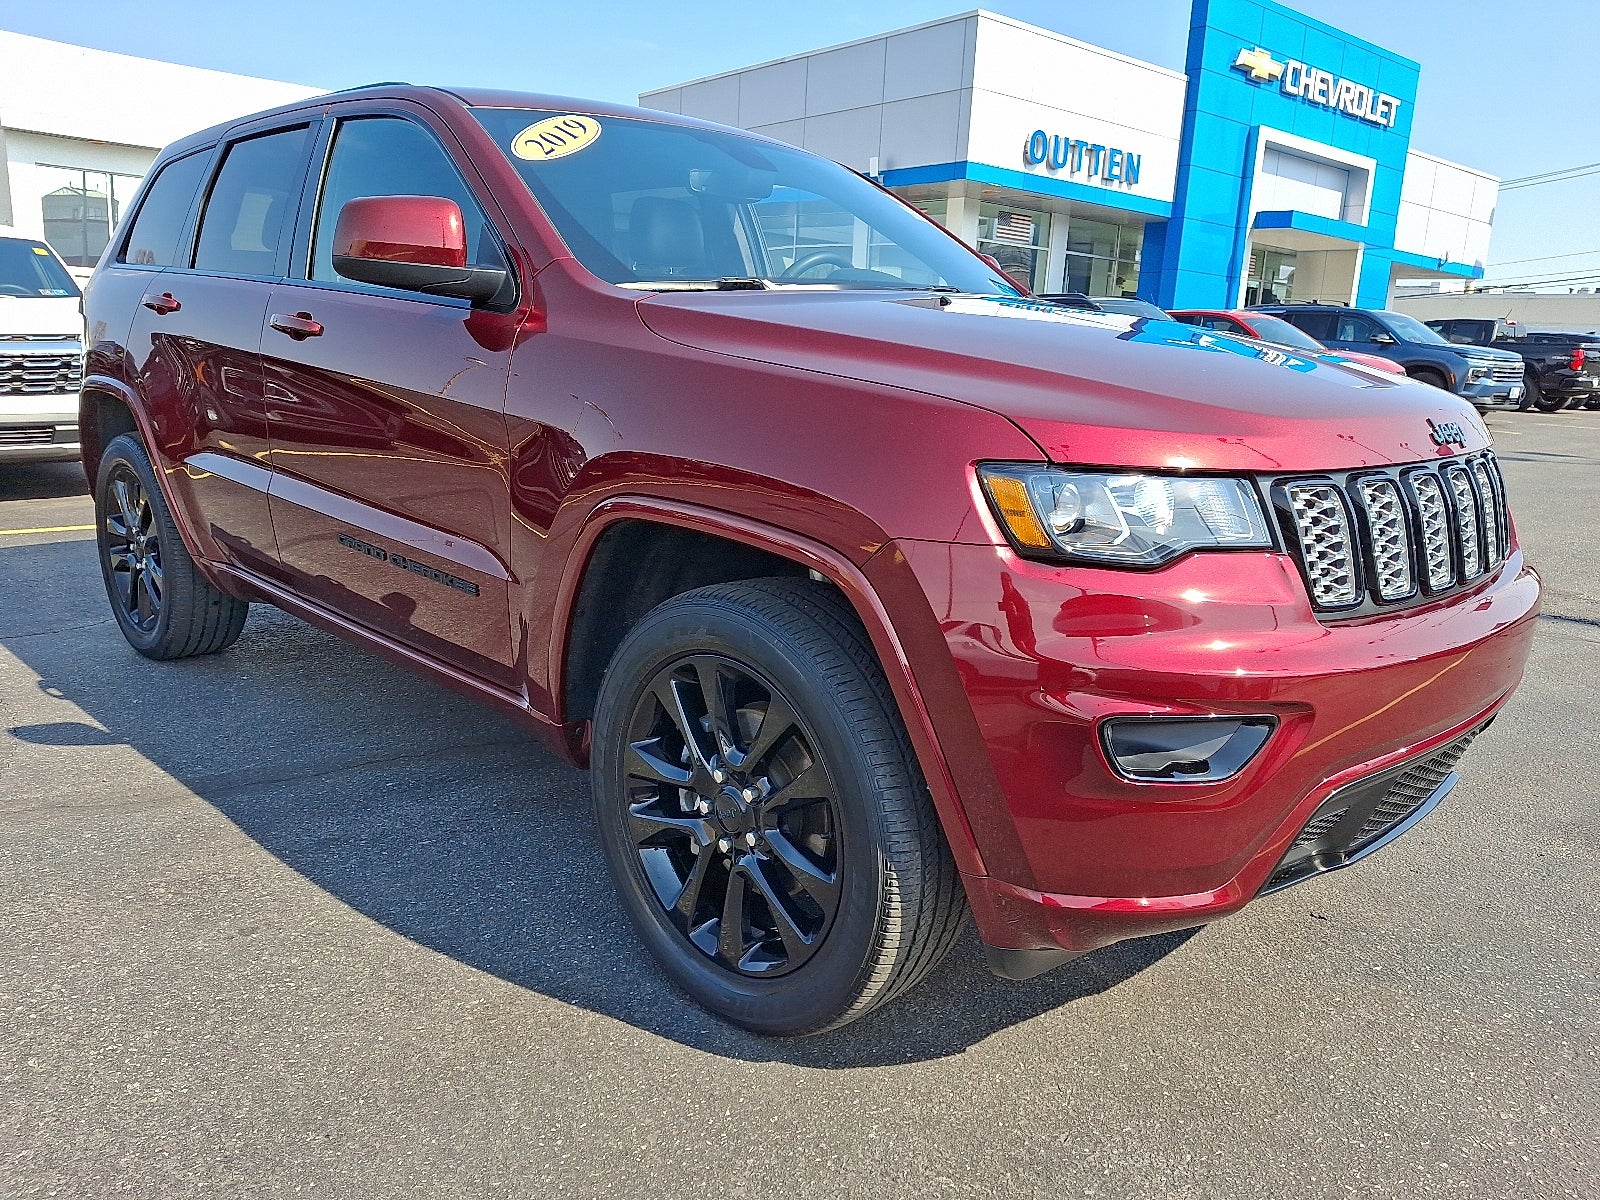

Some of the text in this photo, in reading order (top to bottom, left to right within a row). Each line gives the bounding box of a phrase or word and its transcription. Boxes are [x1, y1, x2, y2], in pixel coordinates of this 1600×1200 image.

[1284, 59, 1401, 128] CHEVROLET
[524, 119, 587, 155] 2019
[1027, 130, 1141, 185] OUTTEN
[1426, 418, 1467, 449] Jeep
[337, 533, 480, 597] GRAND CHEROKEE
